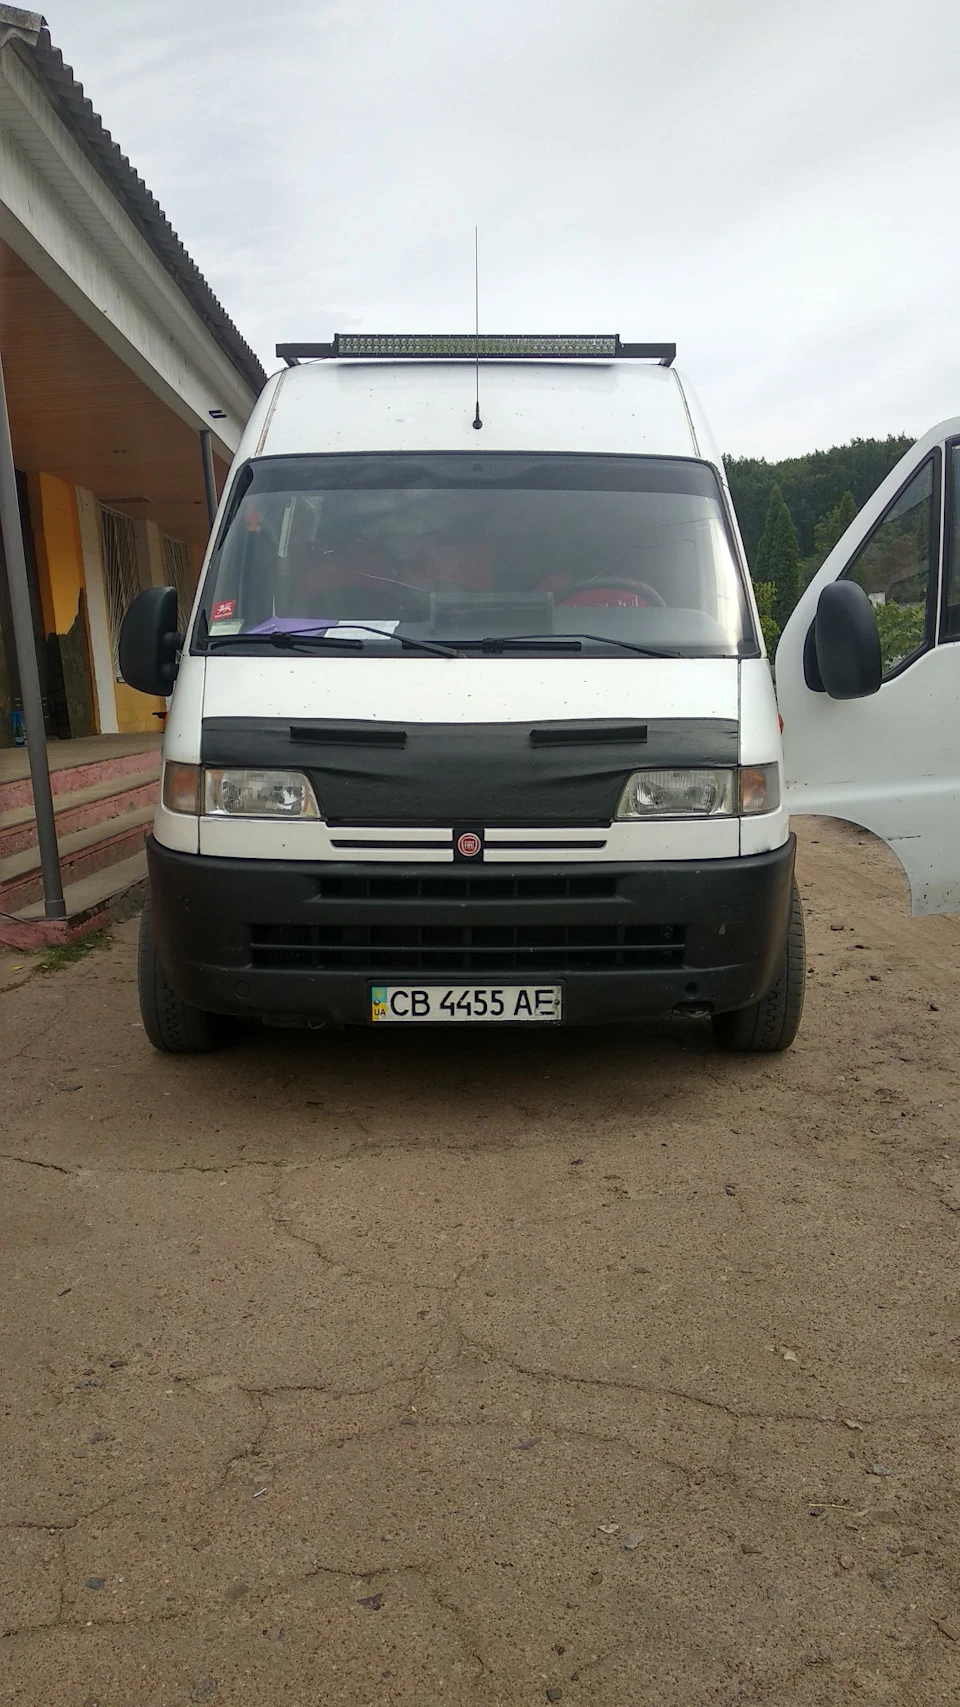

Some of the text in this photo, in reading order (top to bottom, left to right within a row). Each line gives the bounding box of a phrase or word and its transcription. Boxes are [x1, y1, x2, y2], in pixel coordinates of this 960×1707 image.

[390, 990, 555, 1016] CB 4455 AE
[374, 1008, 386, 1016] UA
